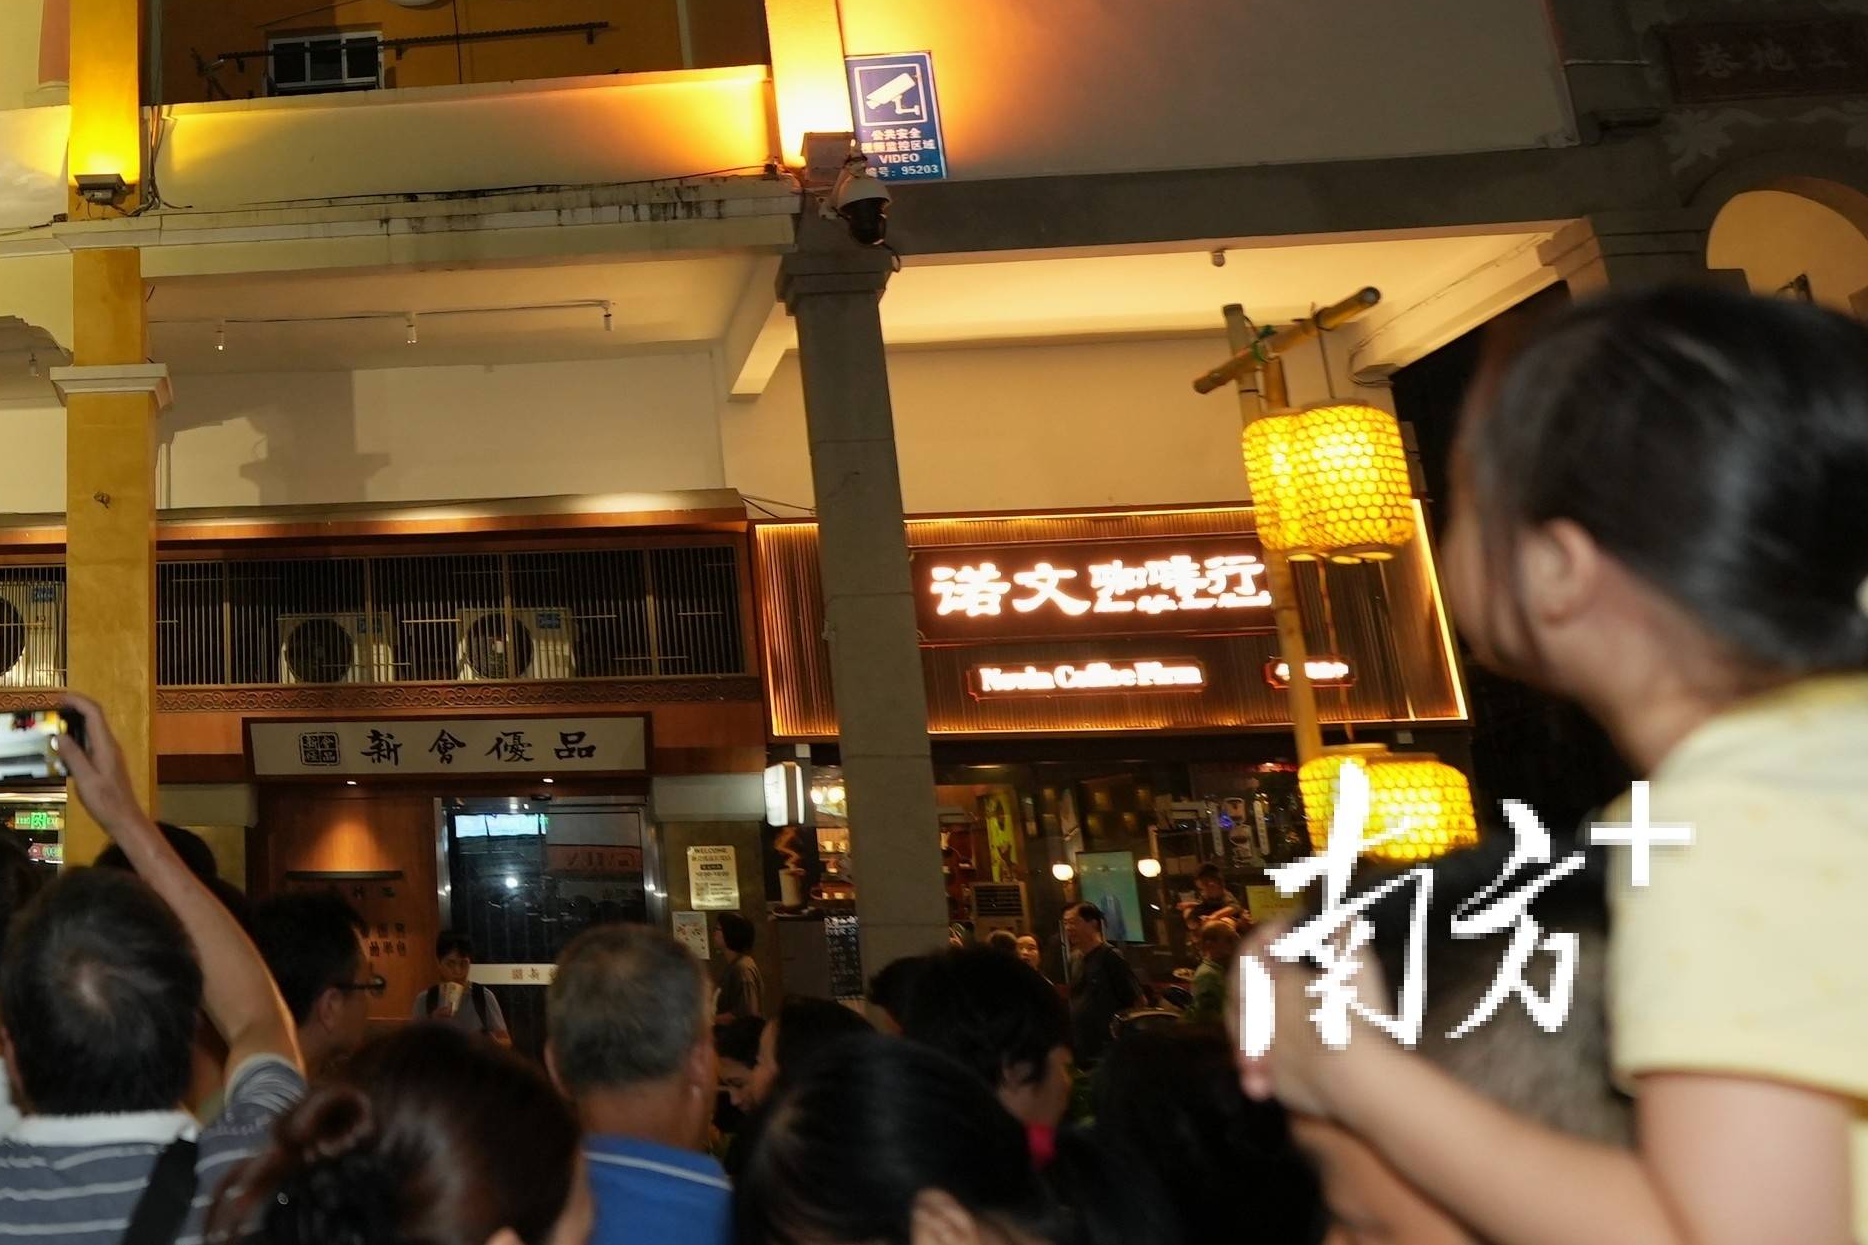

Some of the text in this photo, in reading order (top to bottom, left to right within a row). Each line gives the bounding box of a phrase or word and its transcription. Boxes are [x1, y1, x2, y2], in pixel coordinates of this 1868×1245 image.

[871, 127, 921, 141] 公共安全
[878, 153, 920, 164] VIDEO
[901, 164, 939, 175] 95203
[930, 554, 1266, 617] 诺文咖啡行
